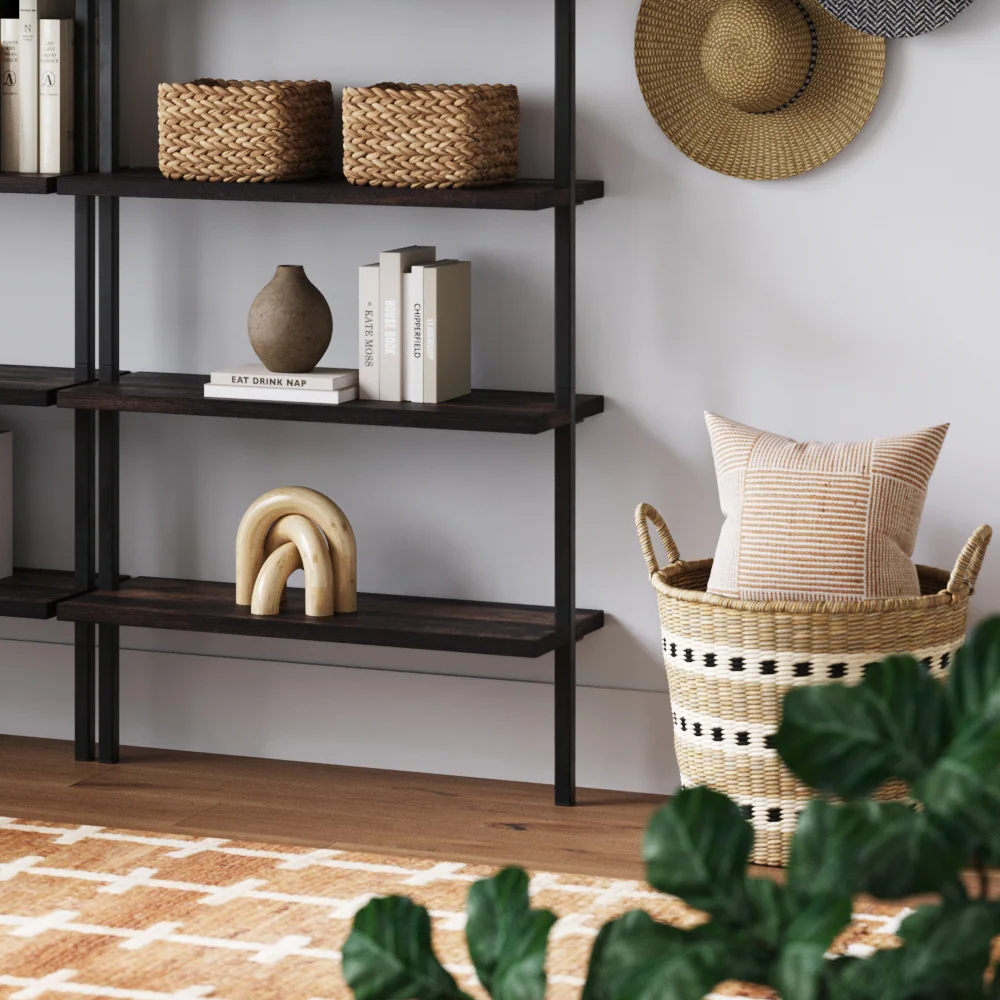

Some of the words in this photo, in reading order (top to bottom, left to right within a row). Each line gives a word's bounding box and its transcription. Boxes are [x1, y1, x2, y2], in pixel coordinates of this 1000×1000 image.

[24, 24, 32, 33] N
[365, 310, 373, 336] KATE
[385, 300, 396, 329] HOUSE
[365, 339, 373, 367] MOSS
[385, 331, 396, 355] BOOK
[232, 376, 249, 384] EAT
[253, 377, 283, 386] DRINK
